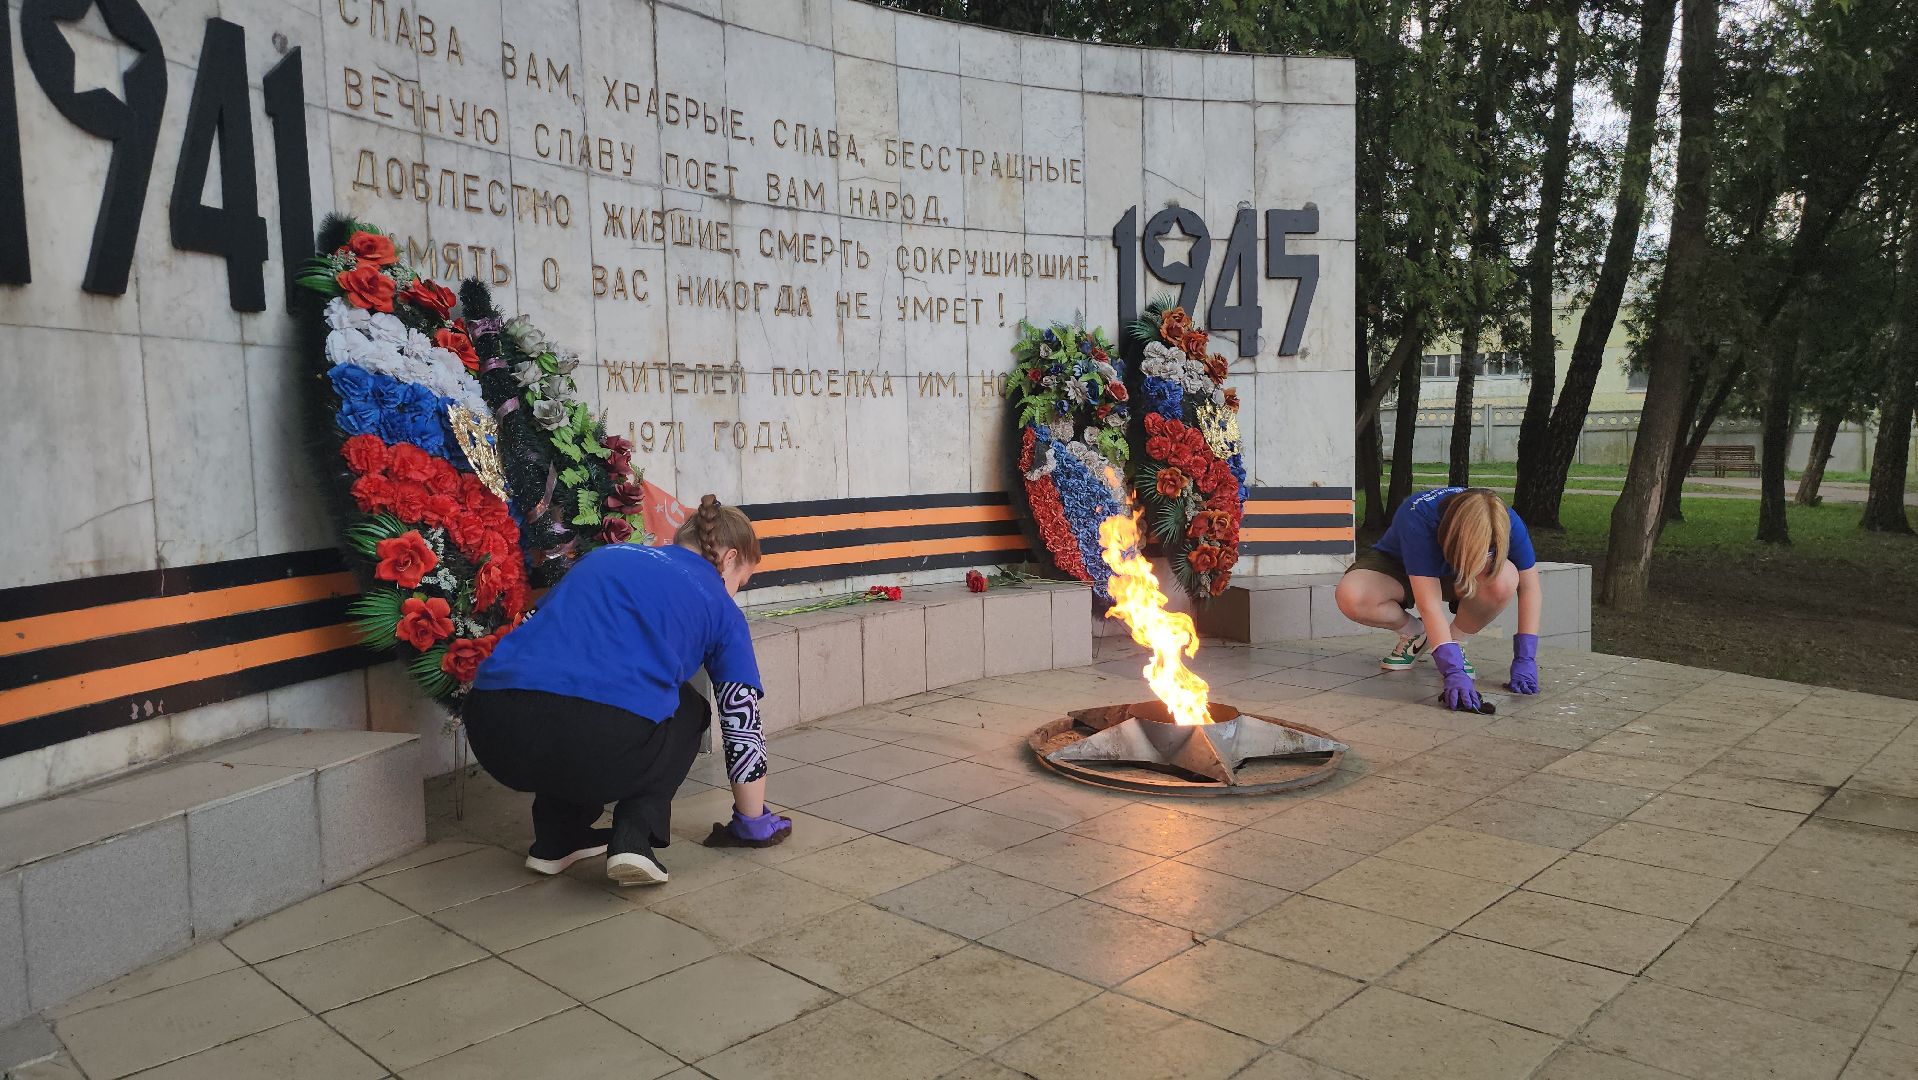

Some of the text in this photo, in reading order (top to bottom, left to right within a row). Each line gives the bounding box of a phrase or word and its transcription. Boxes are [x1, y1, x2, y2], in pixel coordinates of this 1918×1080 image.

[343, 66, 948, 225] ВЕЧНУЮ СЛАВУ ПОЕТ ВАМ НАРОД,
[501, 41, 583, 105] ВАМ,
[603, 76, 755, 146] ХРАБРЫЕ,
[773, 119, 866, 167] СЛАВА,
[885, 138, 1082, 184] БЕССТРАШНЫЕ
[352, 150, 1099, 283] ДОБЛЕСТНО ЖИВШИЕ, СМЕРТЬ СОКРУШИВШИЕ,
[390, 232, 512, 287] МЯТЬ
[542, 257, 561, 293] О
[591, 264, 649, 302] ВАС
[676, 275, 813, 318] НИКОГДА
[836, 291, 871, 320] НЕ
[897, 297, 984, 325] УМРЕТ
[1112, 204, 1319, 357] 1945
[603, 359, 747, 394] ЖИТЕЛЕЙ
[772, 367, 894, 398] ПОСЕЛКА
[918, 370, 963, 398] ИМ.
[629, 421, 800, 453] 1971 ГОДА.
